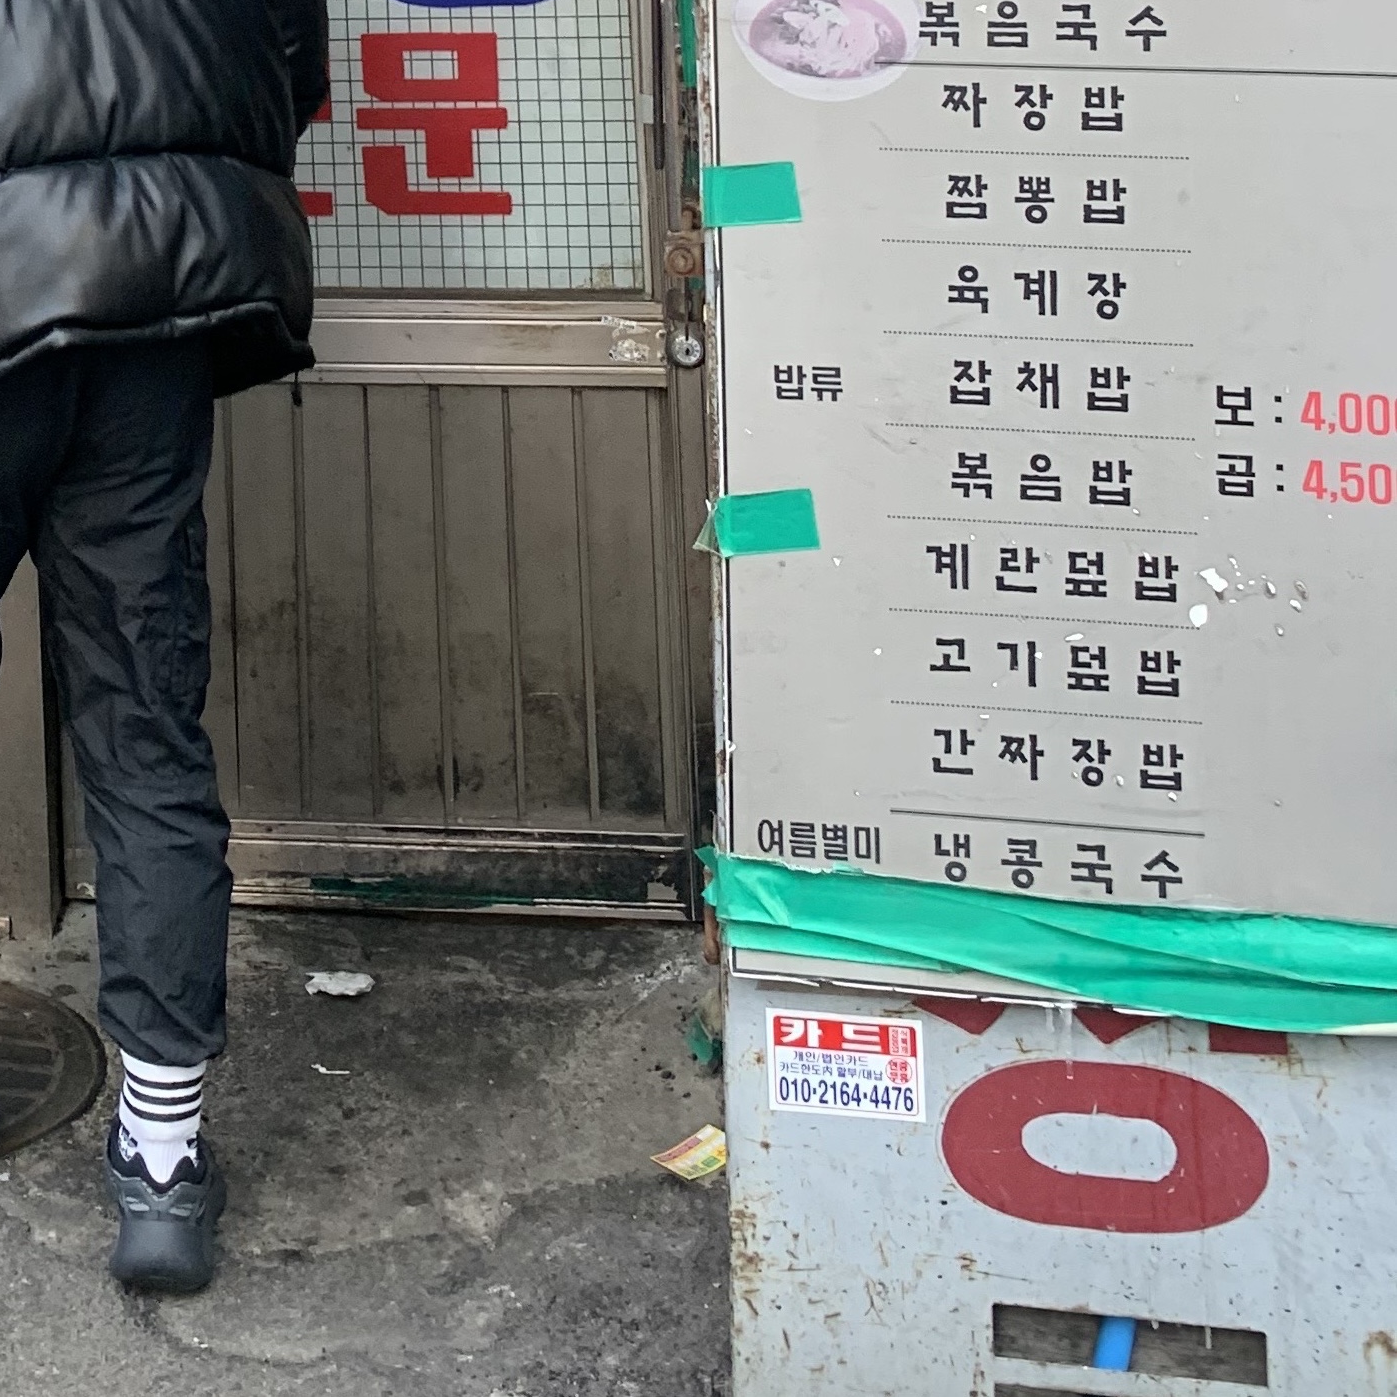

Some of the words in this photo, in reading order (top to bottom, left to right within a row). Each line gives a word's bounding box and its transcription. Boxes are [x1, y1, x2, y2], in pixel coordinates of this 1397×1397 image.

[918, 0, 1168, 53] 볶음국수
[941, 81, 1126, 133] 짜장밥
[945, 173, 1128, 225] 짬뽕밥
[947, 264, 1128, 321] 육계장
[773, 364, 844, 403] 밥류
[949, 359, 1132, 413] 잡채밥
[1300, 390, 1397, 437] 4,00
[950, 451, 1134, 506] 볶음밥
[925, 542, 1180, 603] 계란덮밥
[929, 637, 1182, 698] 고기덮밥
[930, 728, 1185, 792] 간짜장밥
[757, 818, 882, 866] 여름별미
[933, 832, 1184, 900] 냉콩국수
[793, 1051, 869, 1067] 개인/법인카드
